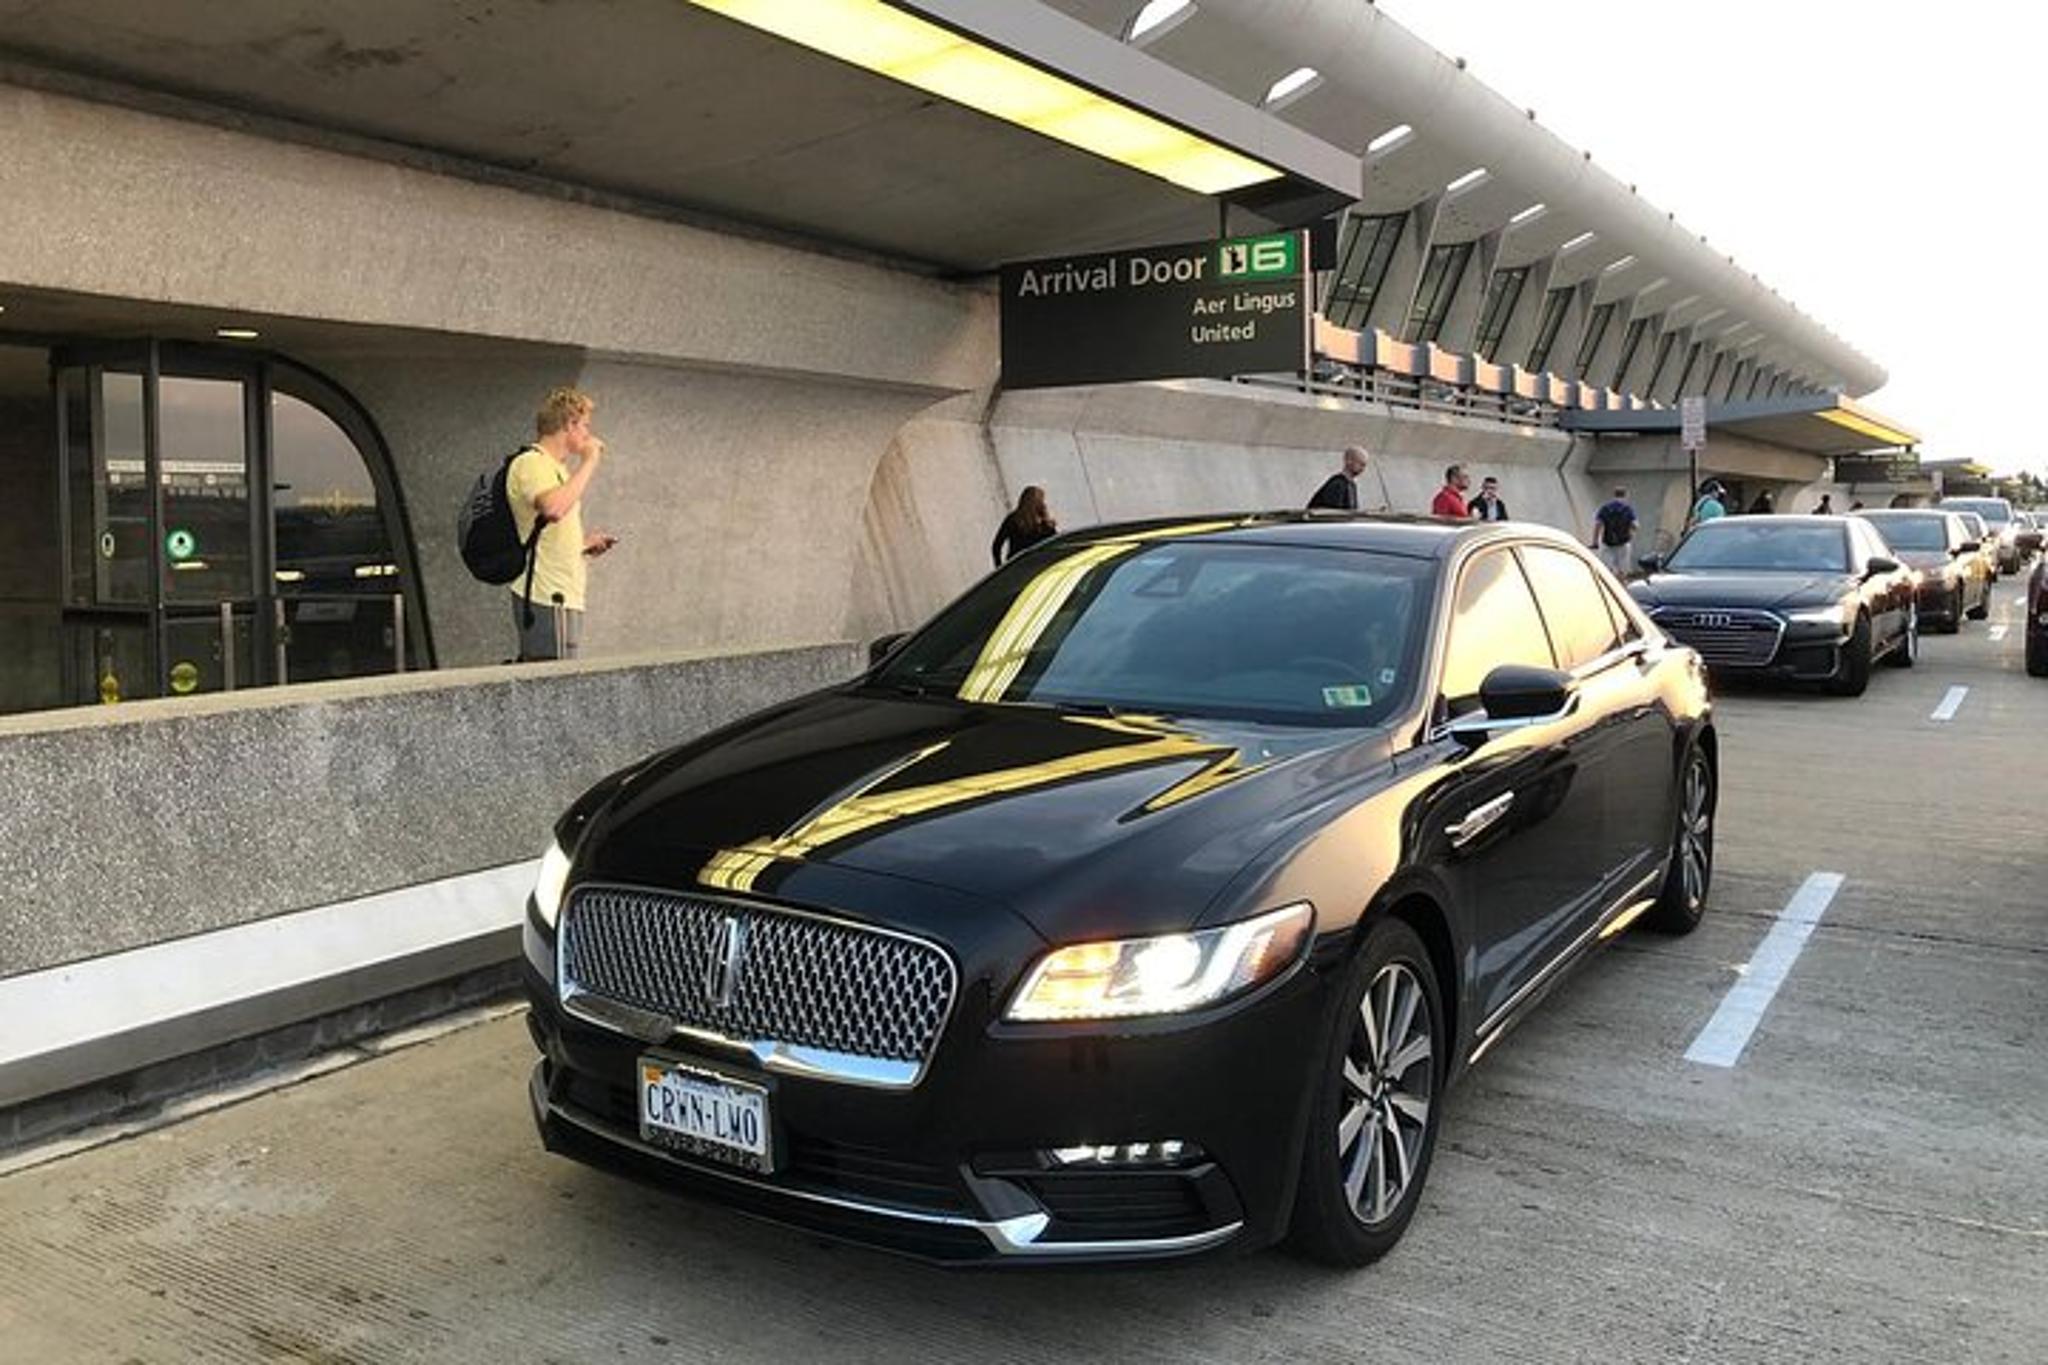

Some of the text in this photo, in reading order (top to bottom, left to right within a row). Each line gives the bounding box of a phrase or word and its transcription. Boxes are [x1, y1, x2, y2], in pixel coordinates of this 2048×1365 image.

[1018, 258, 1117, 297] Arrival
[1130, 255, 1207, 286] Door
[1192, 290, 1296, 316] Aer Lingus
[1191, 320, 1255, 343] United
